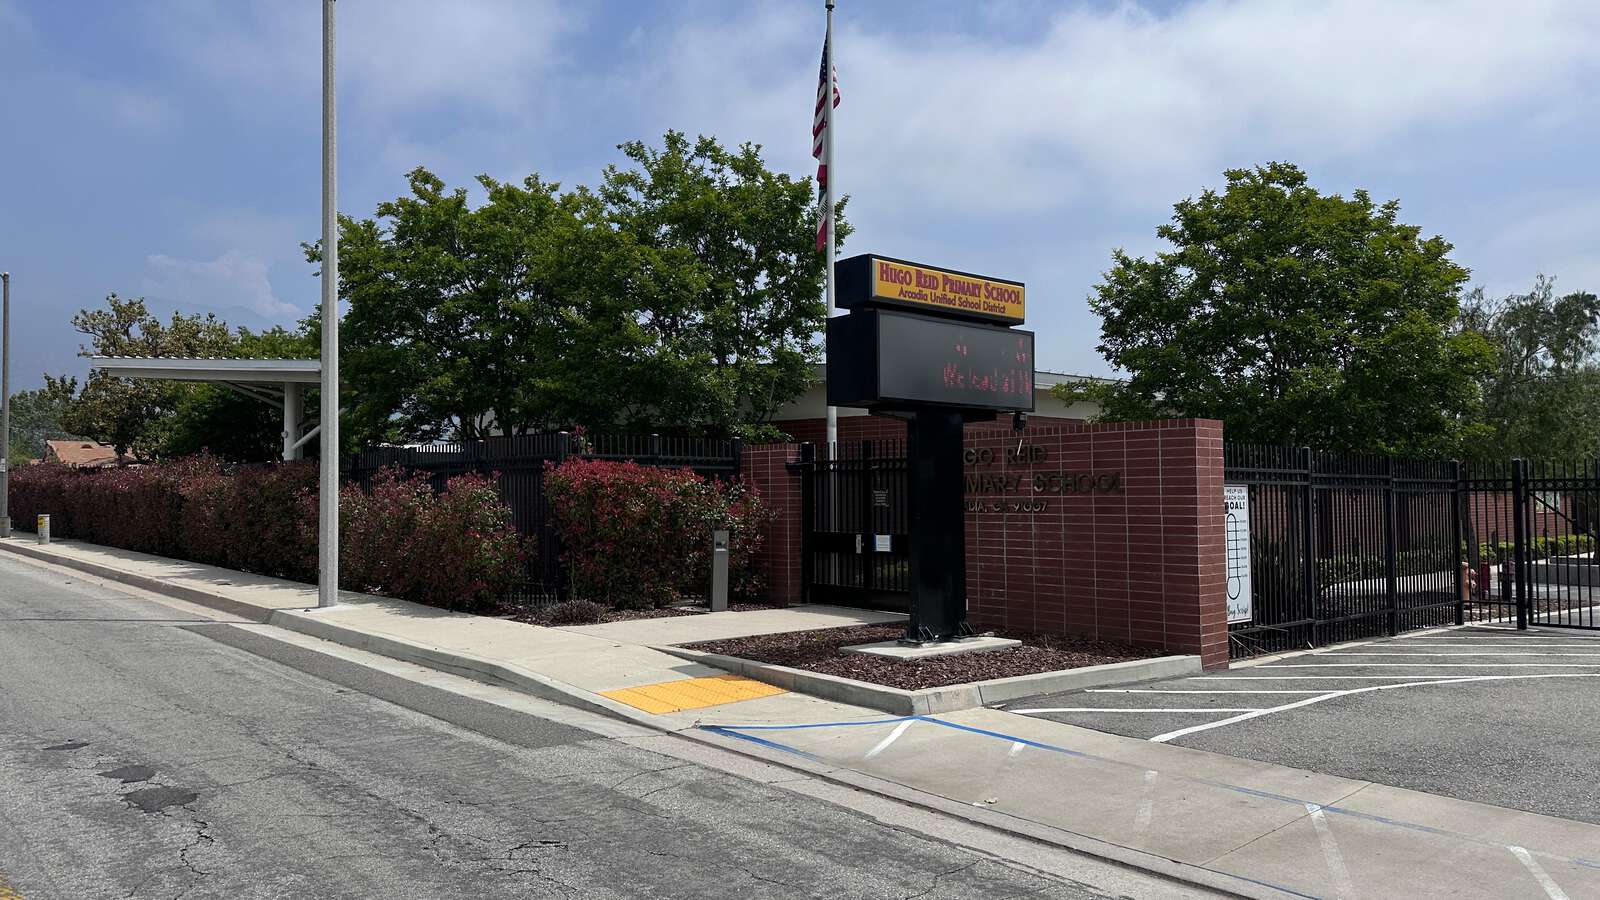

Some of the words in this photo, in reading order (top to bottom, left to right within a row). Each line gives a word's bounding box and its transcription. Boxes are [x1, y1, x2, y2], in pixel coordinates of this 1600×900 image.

[880, 262, 912, 286] HUGO
[915, 269, 940, 291] REID
[942, 273, 982, 298] PRIMARY
[984, 281, 1022, 305] SCHOOL
[898, 286, 928, 301] Arcadia
[930, 291, 957, 306] Unified
[958, 296, 982, 310] School
[983, 300, 1006, 314] District
[963, 447, 993, 465] GO
[1005, 445, 1047, 464] REID
[964, 474, 1022, 493] MARY
[965, 501, 988, 513] DIA,
